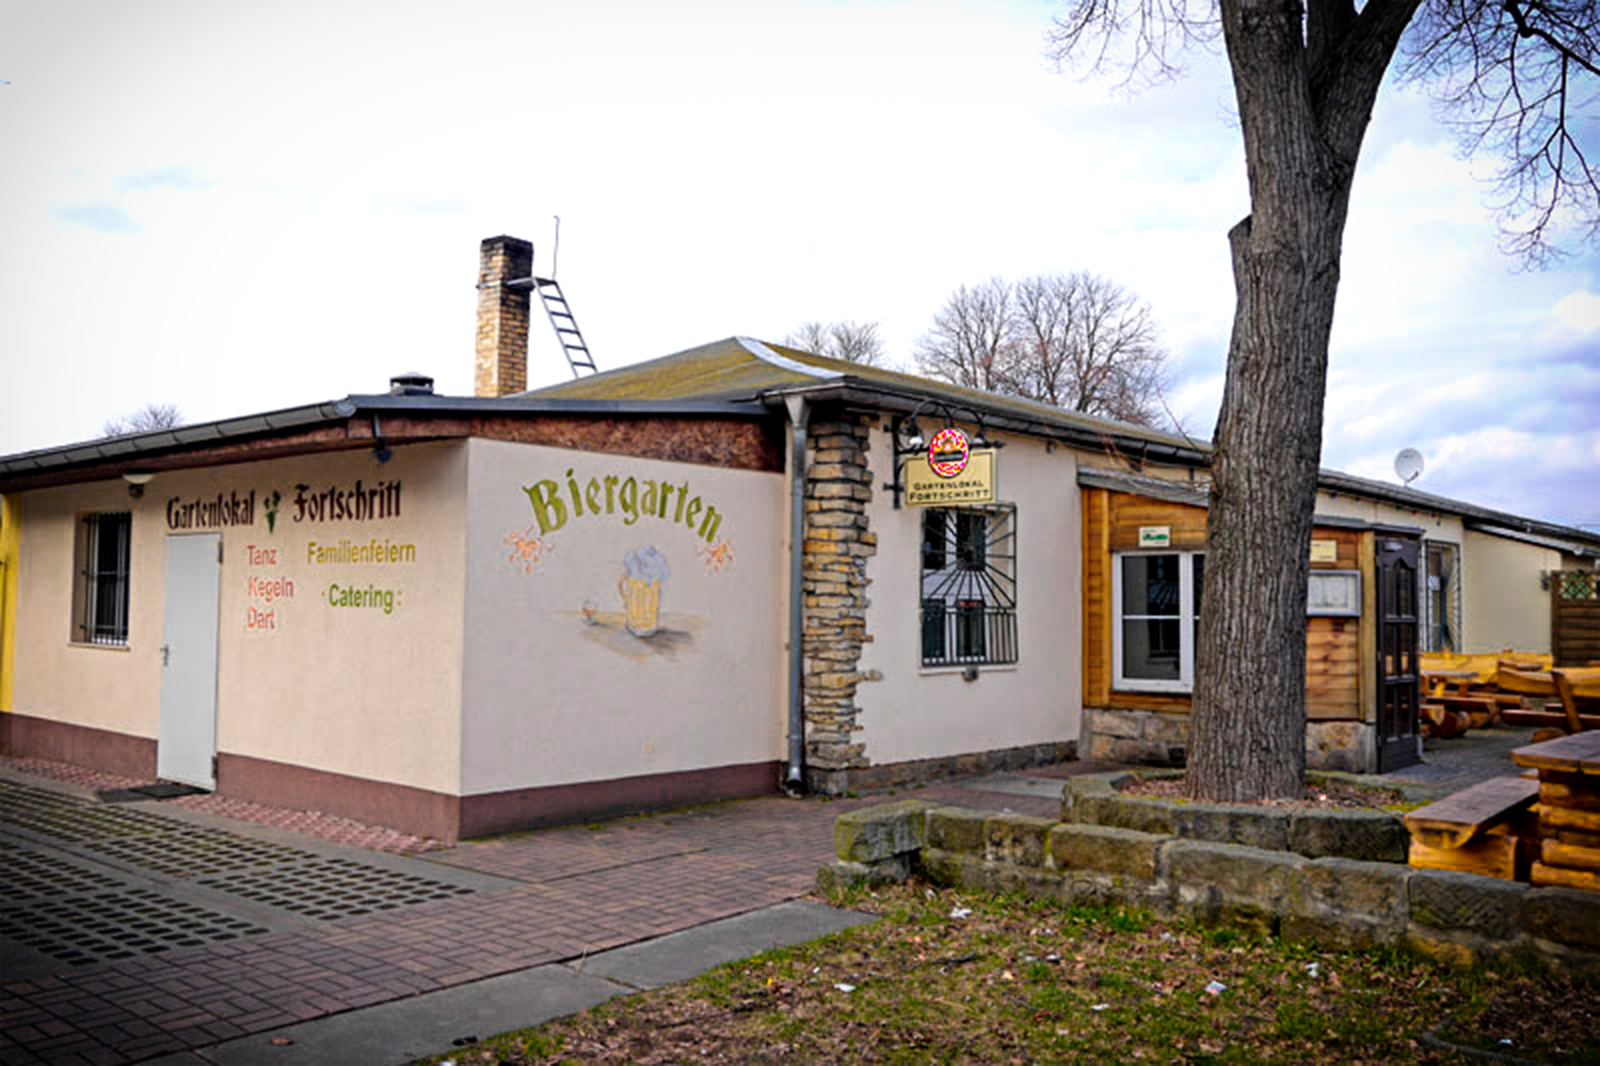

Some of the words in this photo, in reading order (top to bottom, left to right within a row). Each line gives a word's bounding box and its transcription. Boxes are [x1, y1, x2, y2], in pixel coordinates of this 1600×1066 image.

[166, 489, 255, 530] Gartenlokal
[293, 479, 401, 522] Fortschritt
[521, 467, 722, 543] Biergarten
[247, 545, 277, 566] Tanz
[307, 539, 416, 564] Familienfeiern
[248, 576, 294, 602] Kegeln
[329, 584, 394, 615] Catering
[248, 607, 275, 629] Dart
